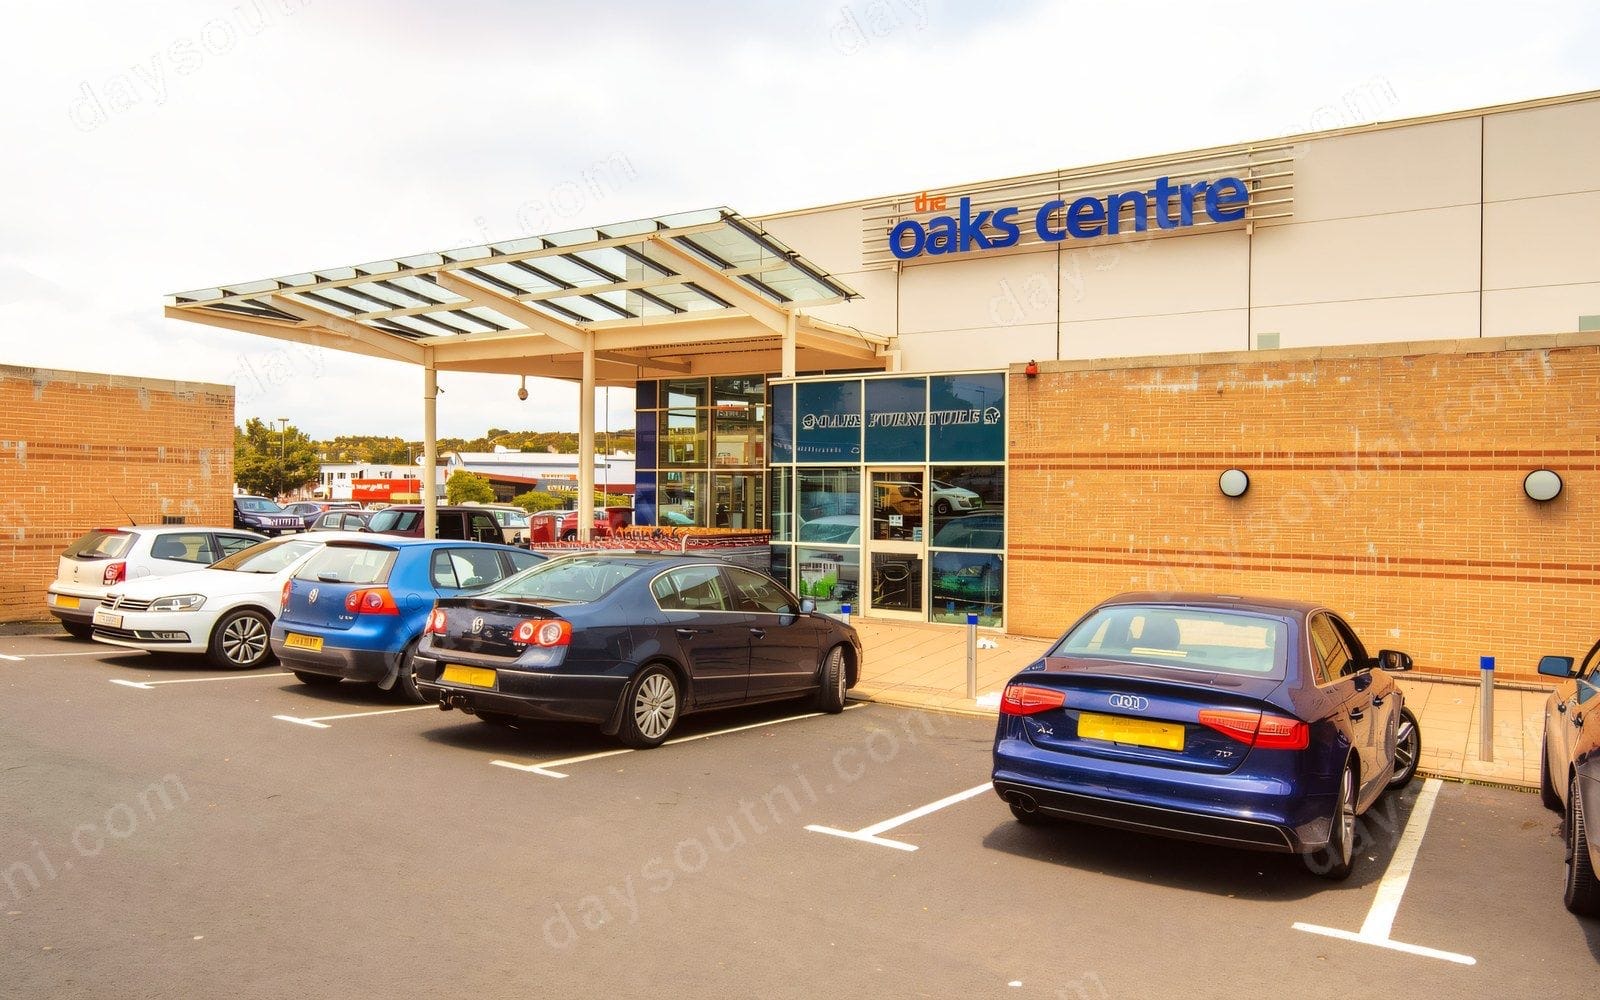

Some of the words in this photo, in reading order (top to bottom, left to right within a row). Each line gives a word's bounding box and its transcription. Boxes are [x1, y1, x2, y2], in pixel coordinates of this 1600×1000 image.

[888, 196, 1020, 260] oaks
[1035, 175, 1249, 242] centre
[915, 191, 947, 213] the
